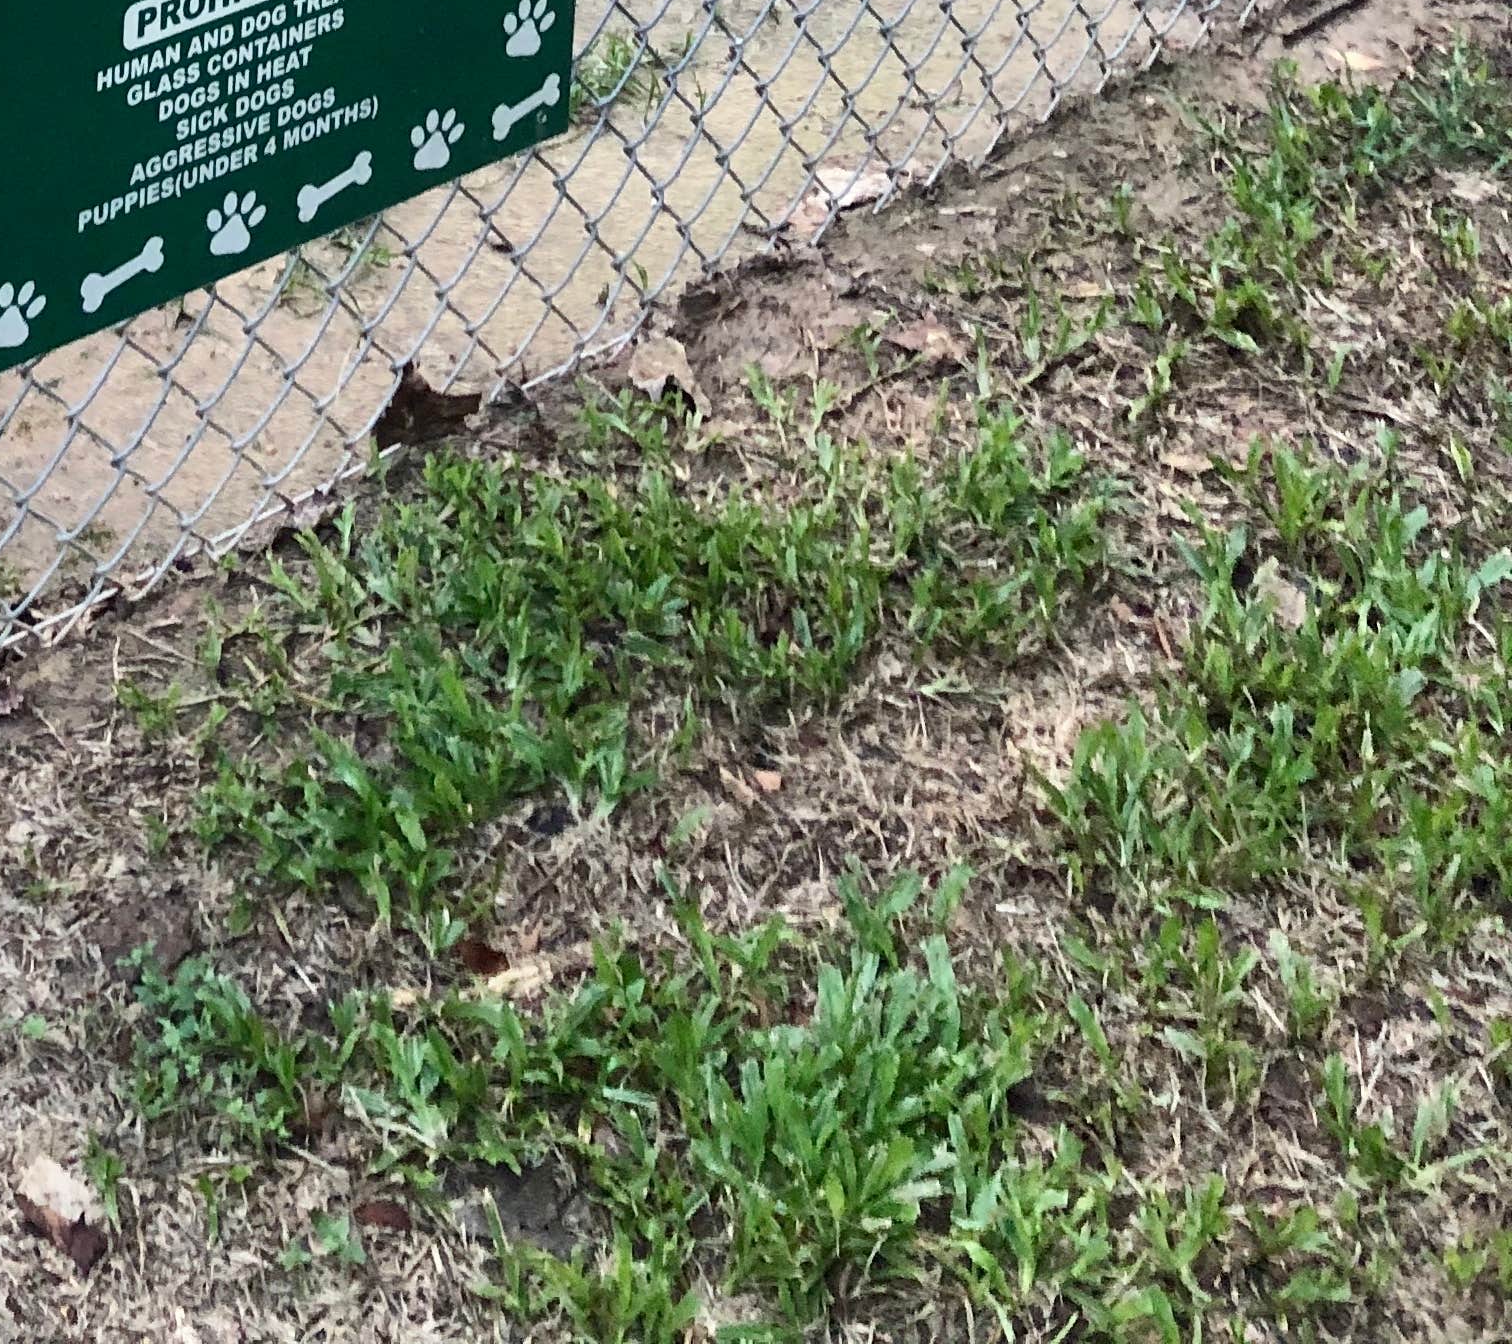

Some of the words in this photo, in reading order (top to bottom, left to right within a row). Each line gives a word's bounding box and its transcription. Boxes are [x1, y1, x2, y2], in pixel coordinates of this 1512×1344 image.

[96, 41, 181, 92] HUMAN
[187, 23, 234, 59] AND
[240, 3, 287, 38] DOG
[126, 61, 201, 106] GLASS
[206, 7, 345, 76] CONTAINERS
[158, 80, 220, 122] DOGS
[227, 68, 250, 95] IN
[256, 43, 313, 84] HEAT
[129, 111, 271, 186] AGGRESSIVE
[277, 86, 335, 127] DOGS
[175, 102, 228, 141] SICK
[235, 77, 295, 118] DOGS
[263, 135, 277, 156] 4
[282, 95, 379, 150] MONTHS)
